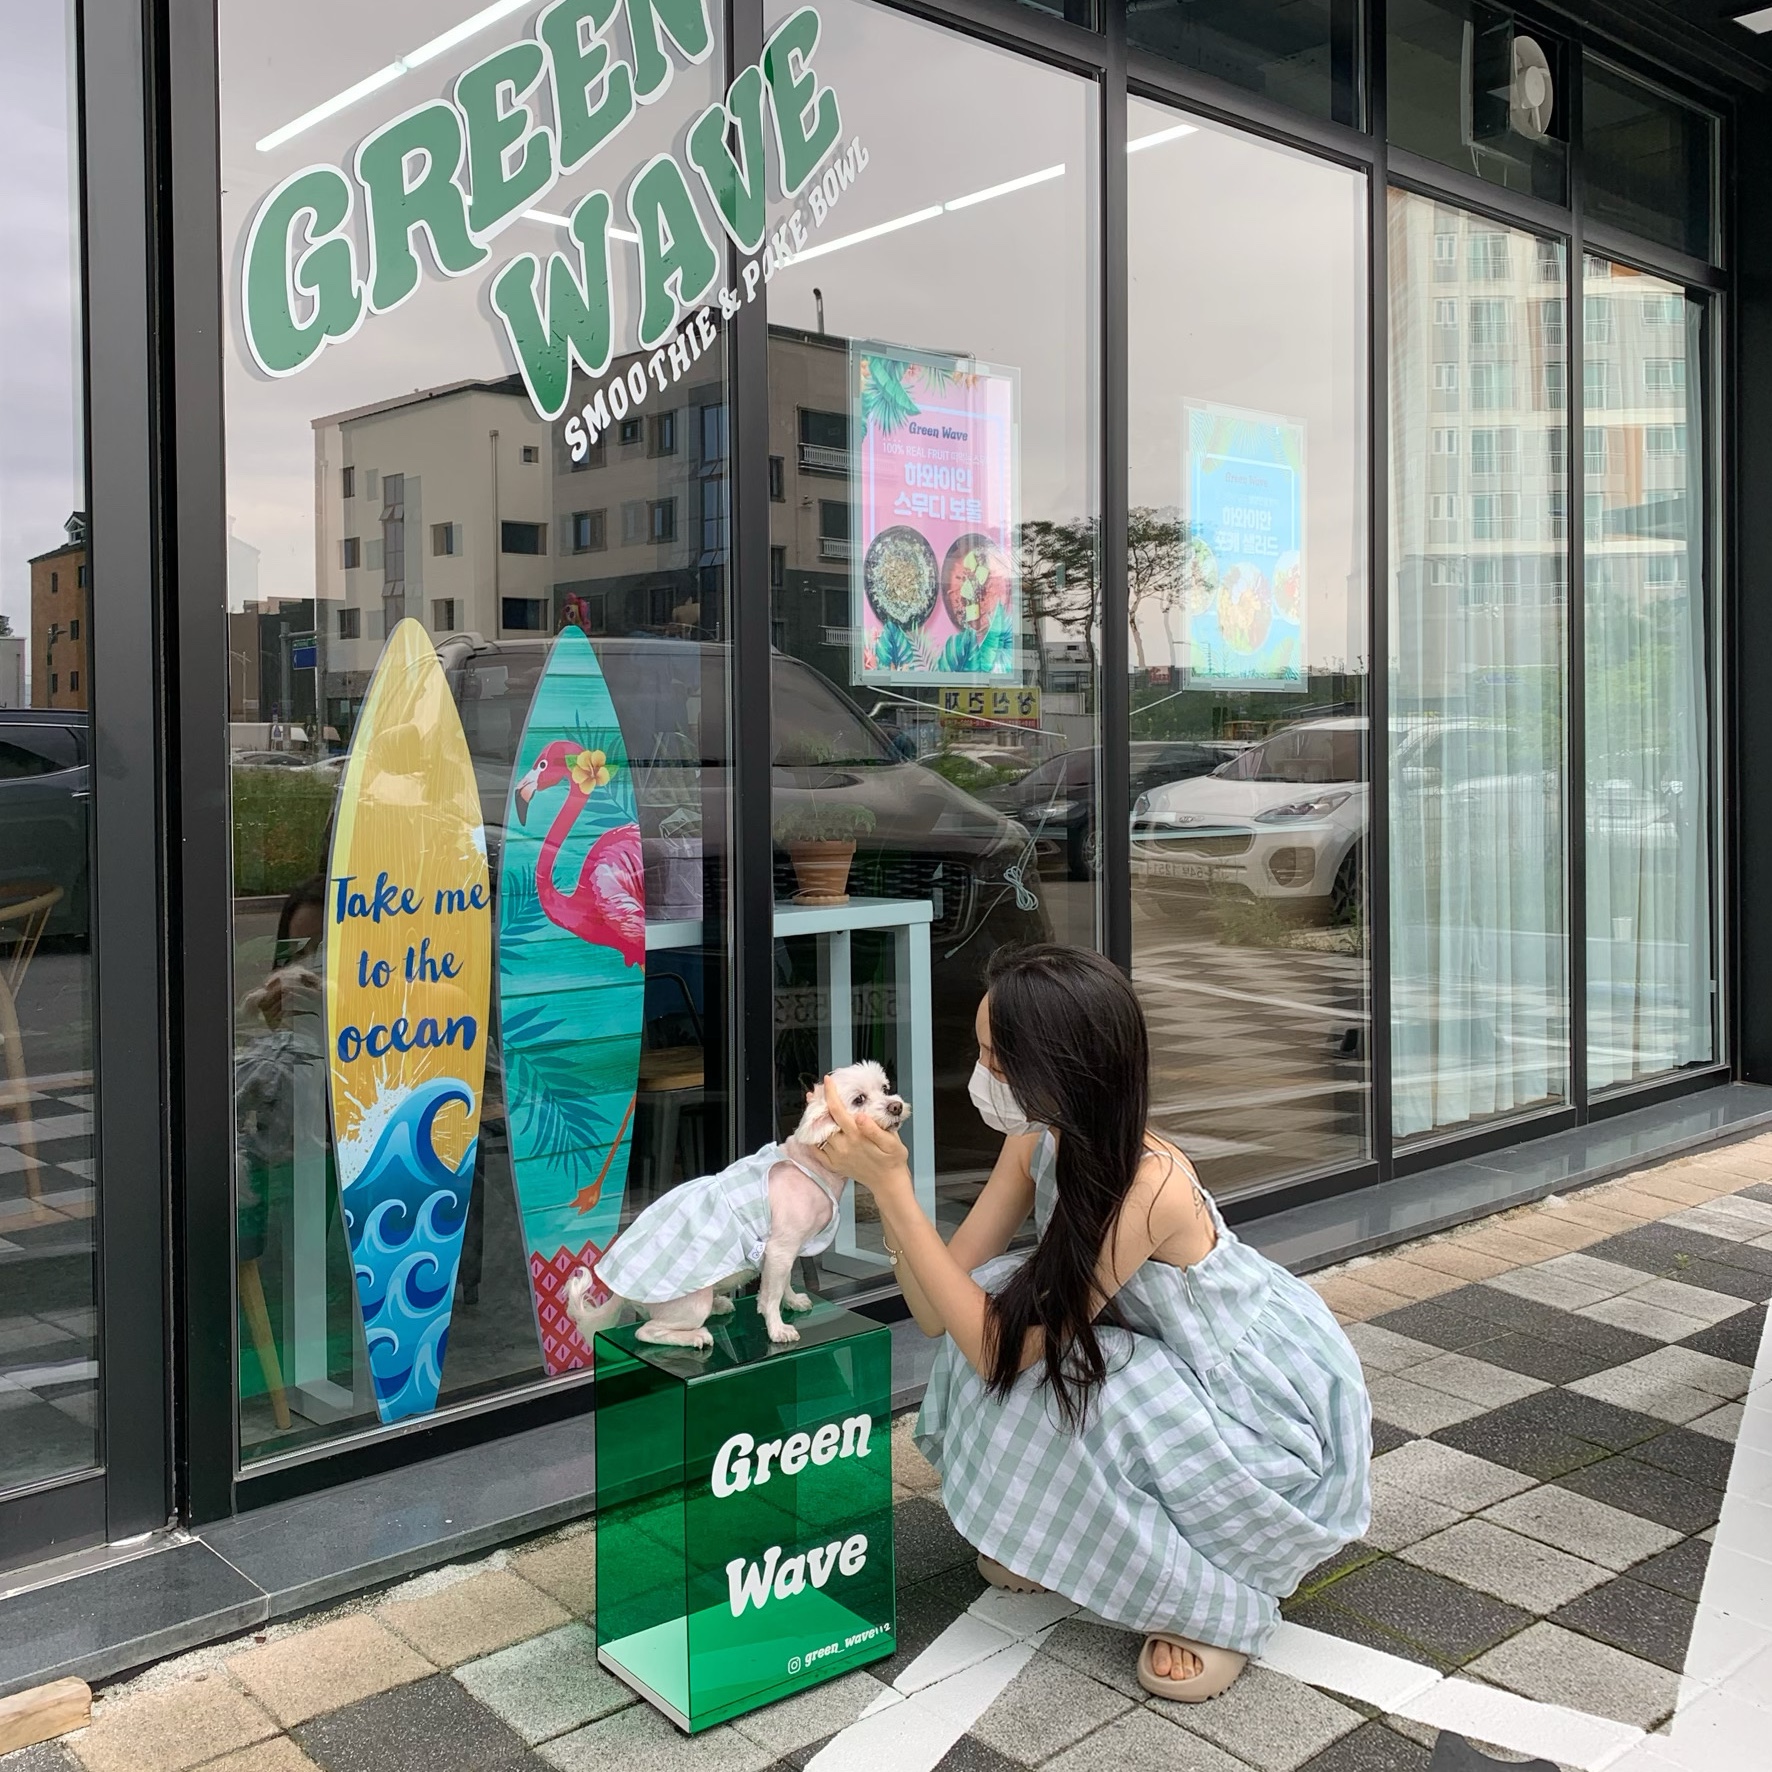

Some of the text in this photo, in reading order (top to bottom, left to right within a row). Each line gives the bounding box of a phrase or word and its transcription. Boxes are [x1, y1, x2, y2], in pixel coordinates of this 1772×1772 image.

[242, 0, 715, 379] GREEN
[490, 7, 843, 423] WAVE
[564, 136, 870, 463] SMOOTHIE & POKE BOWL
[882, 442, 904, 455] 100%
[906, 445, 926, 459] REAL
[927, 448, 951, 461] FRUIT
[908, 421, 969, 442] Green Wave
[893, 490, 946, 520] 스무디
[1222, 506, 1273, 531] 하와이안
[331, 871, 491, 924] Take me
[356, 937, 464, 988] to the
[337, 1015, 477, 1063] ocean
[711, 1413, 873, 1498] Green
[726, 1534, 868, 1618] Wave
